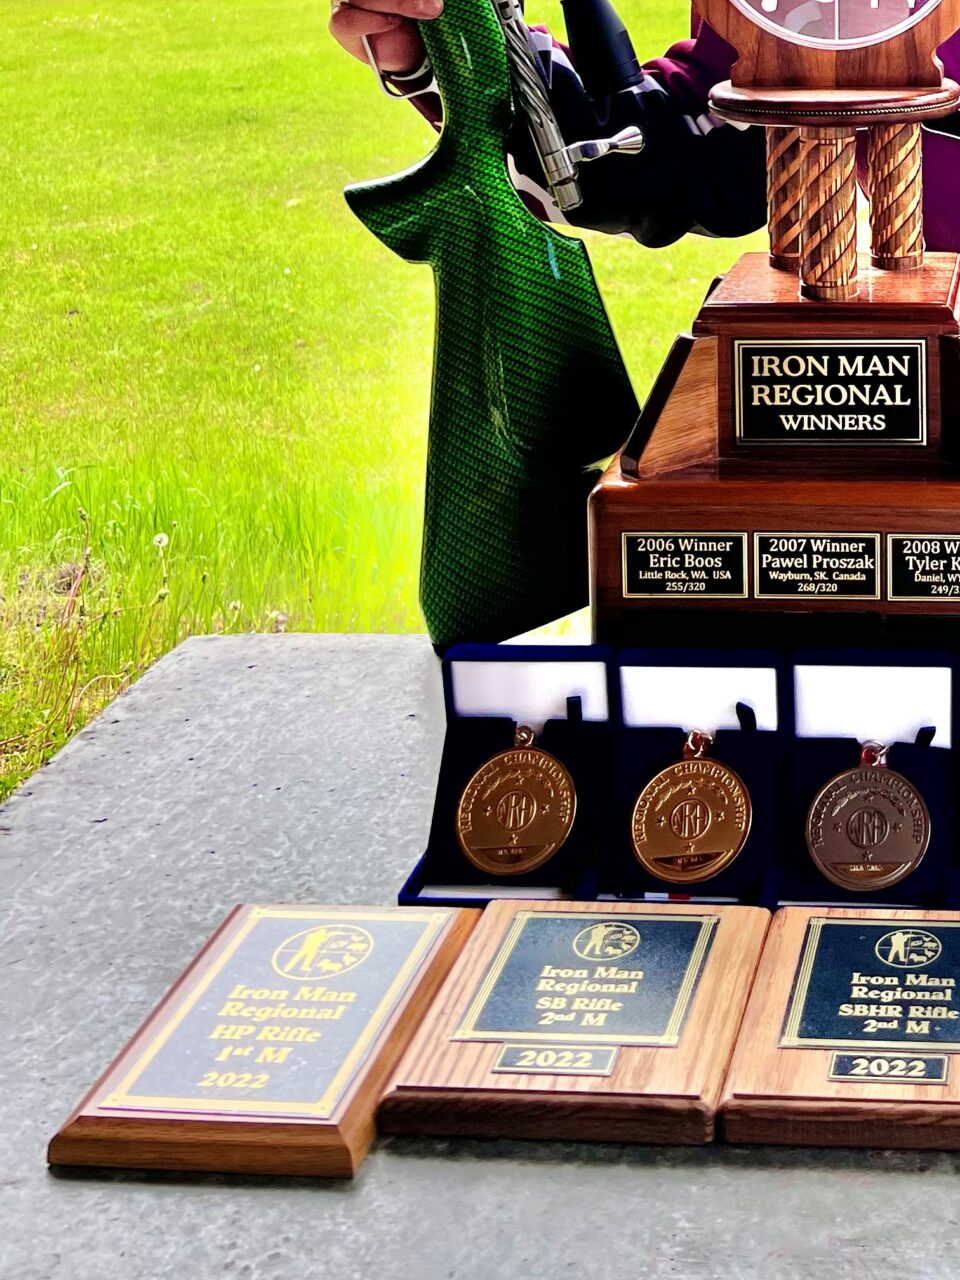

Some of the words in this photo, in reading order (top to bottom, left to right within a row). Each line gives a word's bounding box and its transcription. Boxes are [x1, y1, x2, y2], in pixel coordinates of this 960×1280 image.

[751, 355, 829, 377] IRON
[838, 355, 910, 377] MAN
[751, 384, 911, 406] REGIONAL
[778, 414, 886, 431] WINNERS
[637, 538, 675, 552] 2006
[678, 538, 733, 552] Winner
[769, 538, 807, 552] 2007
[810, 539, 866, 553] Winner
[902, 540, 940, 554] 2008
[649, 554, 680, 568] Eric
[684, 554, 722, 568] Boos
[761, 554, 808, 568] Pawel
[812, 554, 875, 569] Proszak
[905, 556, 947, 574] Tyler
[639, 570, 663, 580] Little
[664, 570, 689, 581] Rock,
[712, 571, 732, 580] USA
[832, 571, 866, 580] Canada
[914, 572, 945, 583] Daniel,
[665, 582, 706, 593] 255/320
[797, 583, 838, 594] 268/320
[633, 774, 671, 845] REGIONAL
[674, 762, 747, 832] CHAMPIONSHIP
[539, 965, 589, 979] Iron
[592, 966, 644, 980] Man
[850, 972, 899, 985] Iron
[904, 973, 956, 987] Man
[227, 984, 289, 1000] Iron
[292, 986, 357, 1002] Man
[535, 978, 638, 995] Regional
[850, 986, 952, 1003] Regional
[217, 1001, 347, 1022] Regional
[535, 997, 567, 1010] SB
[570, 997, 624, 1012] Rifle
[838, 1003, 904, 1017] SBHR
[907, 1005, 960, 1019] Rifle
[537, 1012, 576, 1025] 2nd
[579, 1012, 609, 1027] M
[862, 1019, 899, 1033] 2nd
[905, 1020, 931, 1034] M
[208, 1024, 256, 1040] HP
[255, 1025, 322, 1043] Rifle
[214, 1045, 254, 1062] 1st
[254, 1047, 294, 1064] M
[515, 1050, 593, 1068] 2022
[849, 1058, 927, 1077] 2022
[196, 1071, 270, 1088] 2022
